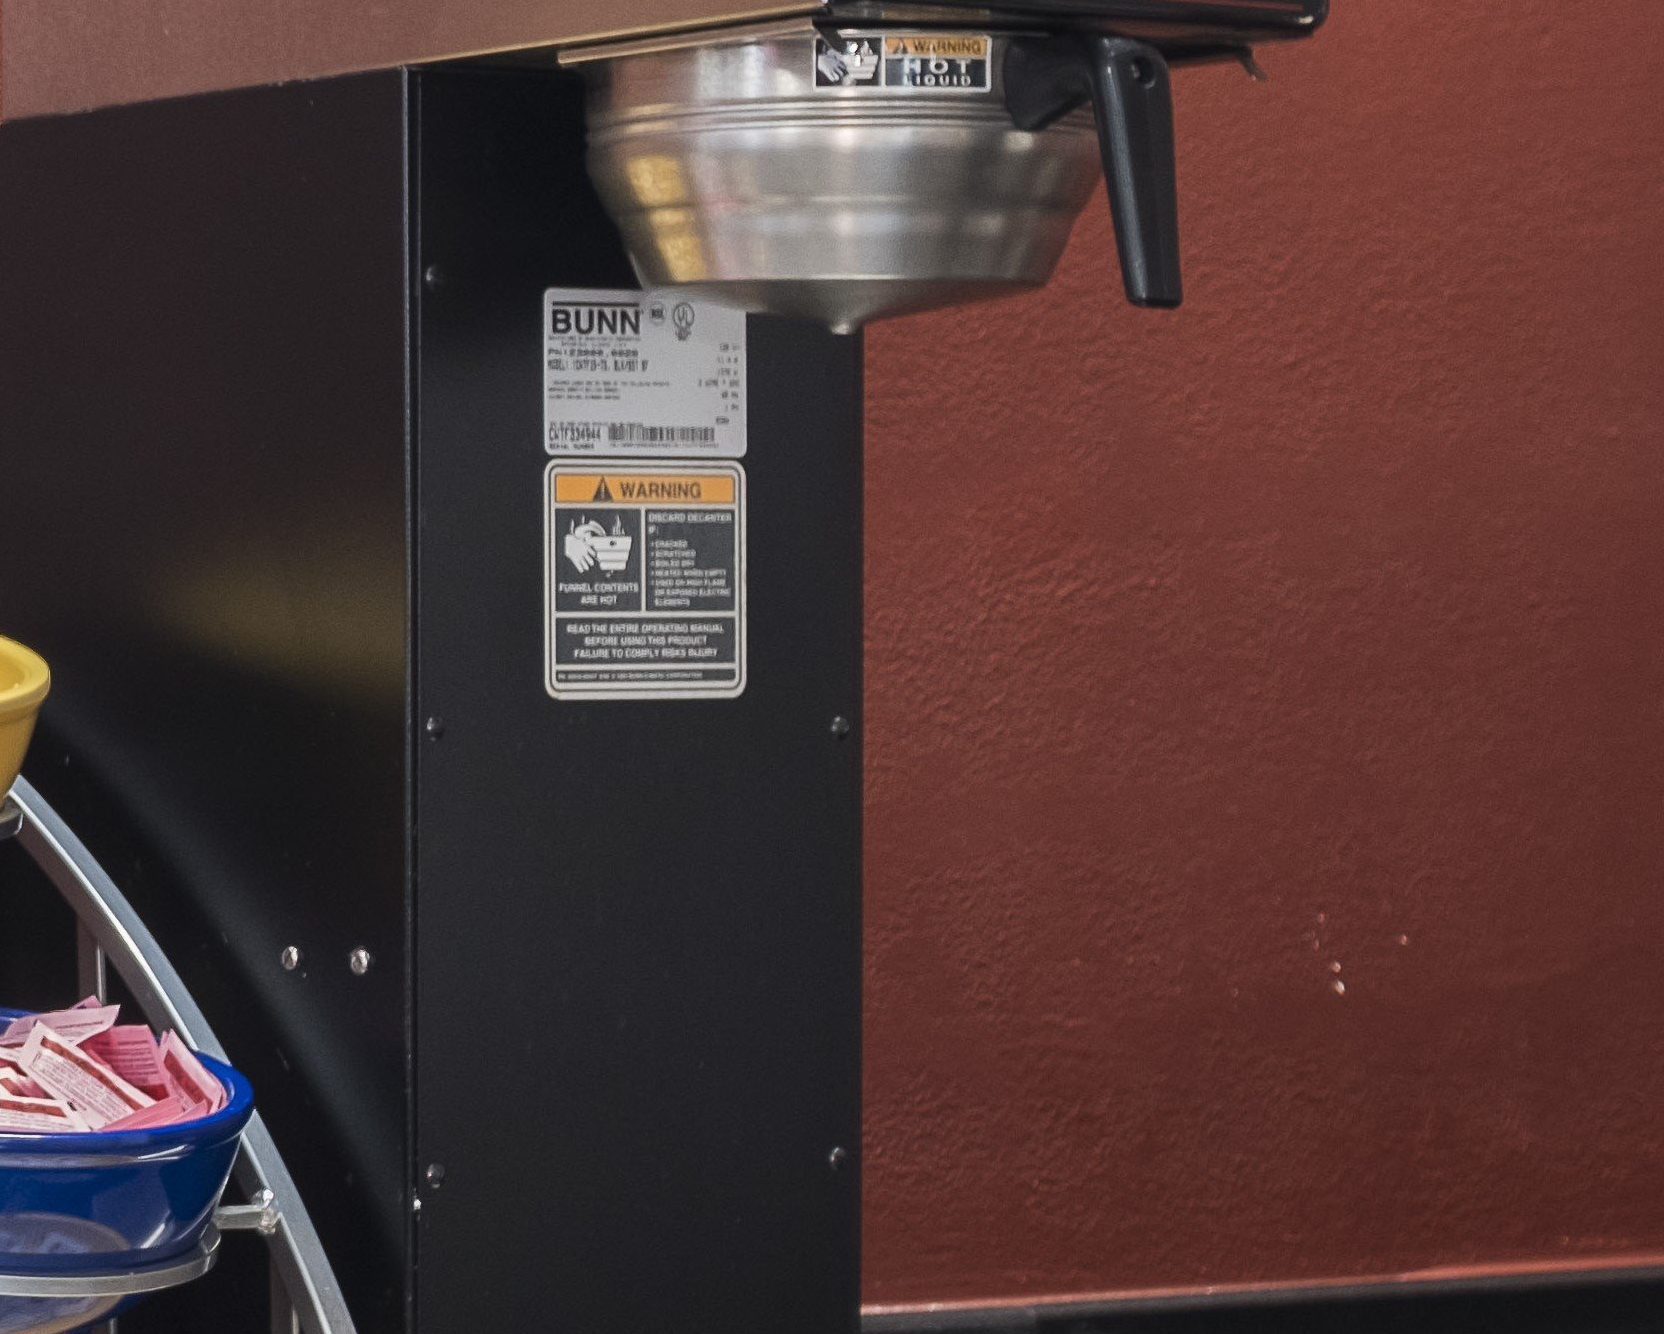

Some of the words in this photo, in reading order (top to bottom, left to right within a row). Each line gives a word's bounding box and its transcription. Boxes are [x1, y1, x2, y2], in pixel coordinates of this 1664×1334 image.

[913, 39, 981, 55] WARNING
[902, 58, 970, 75] HOT
[903, 74, 971, 87] LIQUID
[551, 308, 641, 335] BUNN
[619, 481, 702, 499] WARNING
